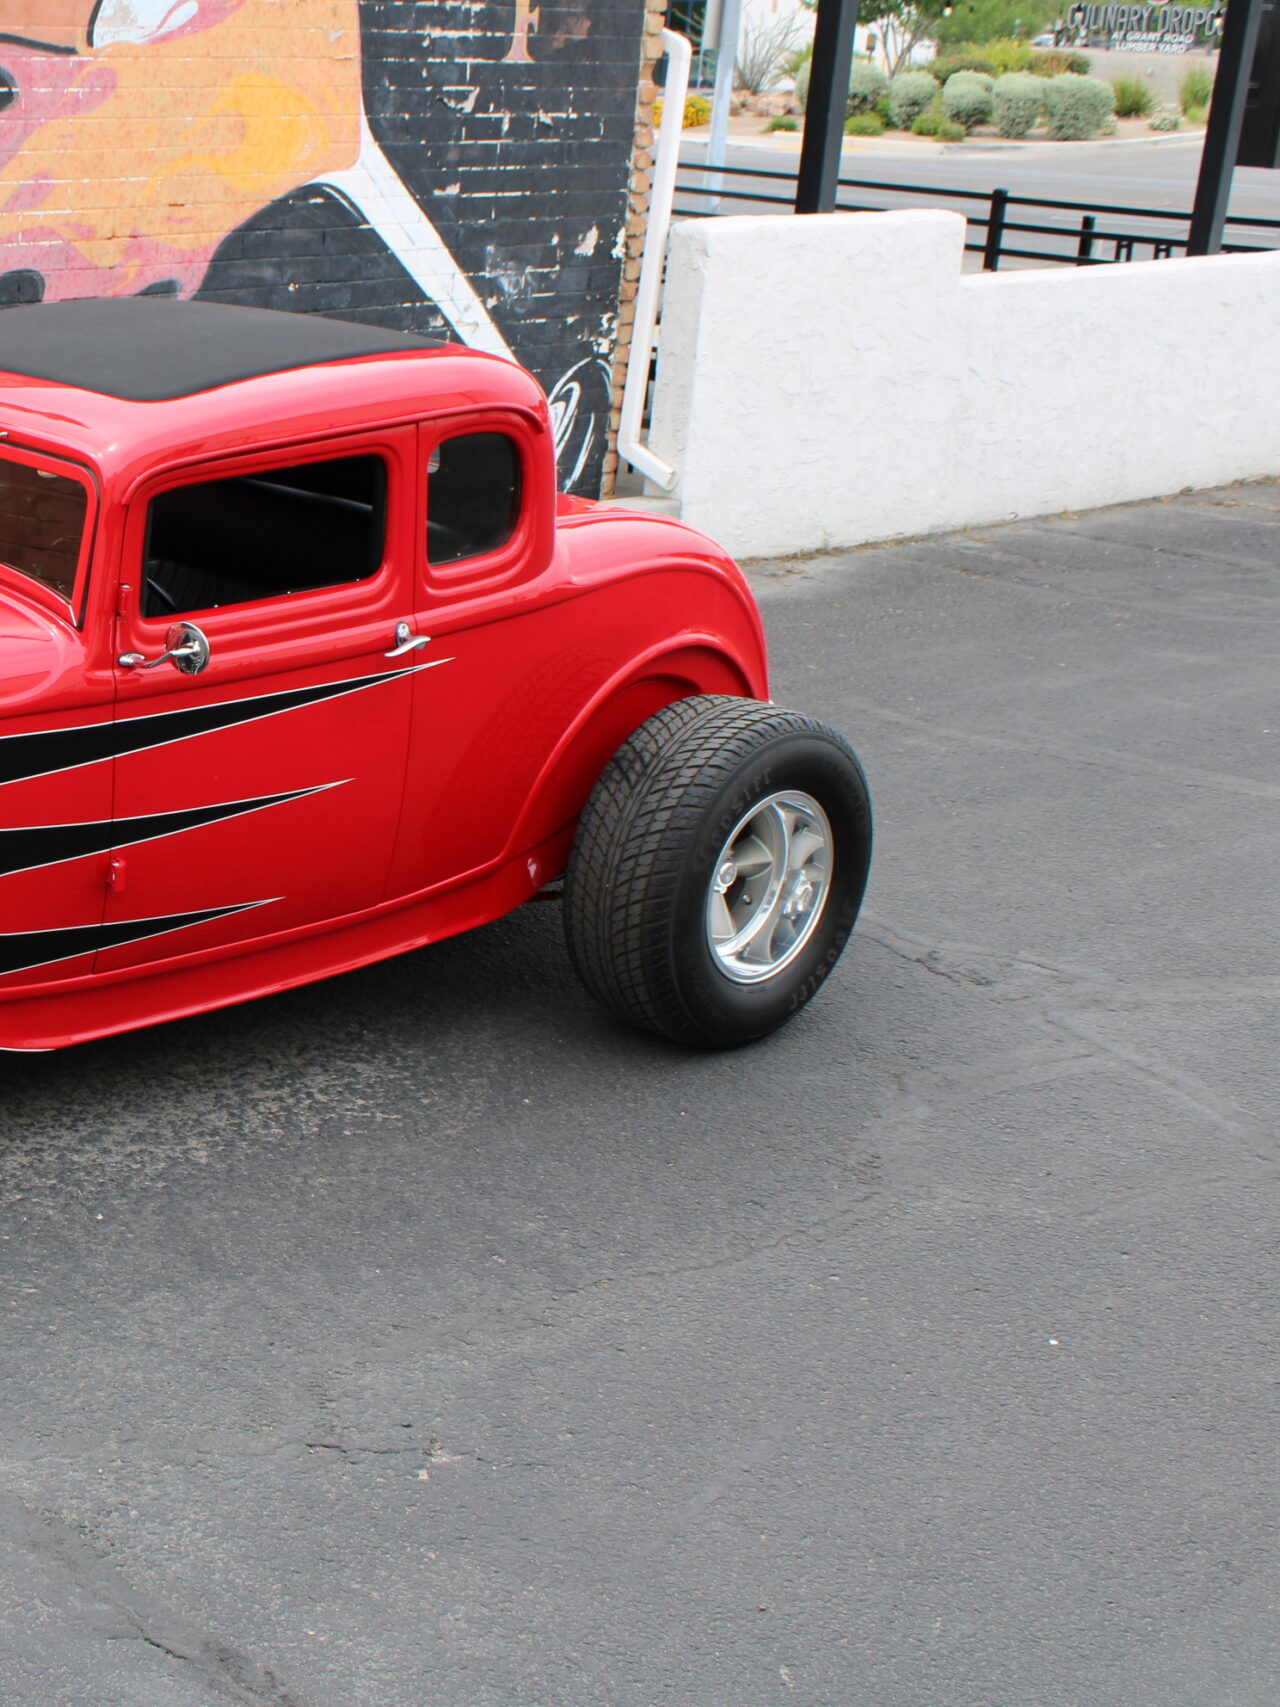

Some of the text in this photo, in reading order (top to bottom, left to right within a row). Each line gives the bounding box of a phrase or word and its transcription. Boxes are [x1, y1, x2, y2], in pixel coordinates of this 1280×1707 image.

[1067, 4, 1153, 32] CULINARY
[1111, 30, 1195, 44] AT GRANT ROAD
[1115, 41, 1187, 54] LUMBER YARD
